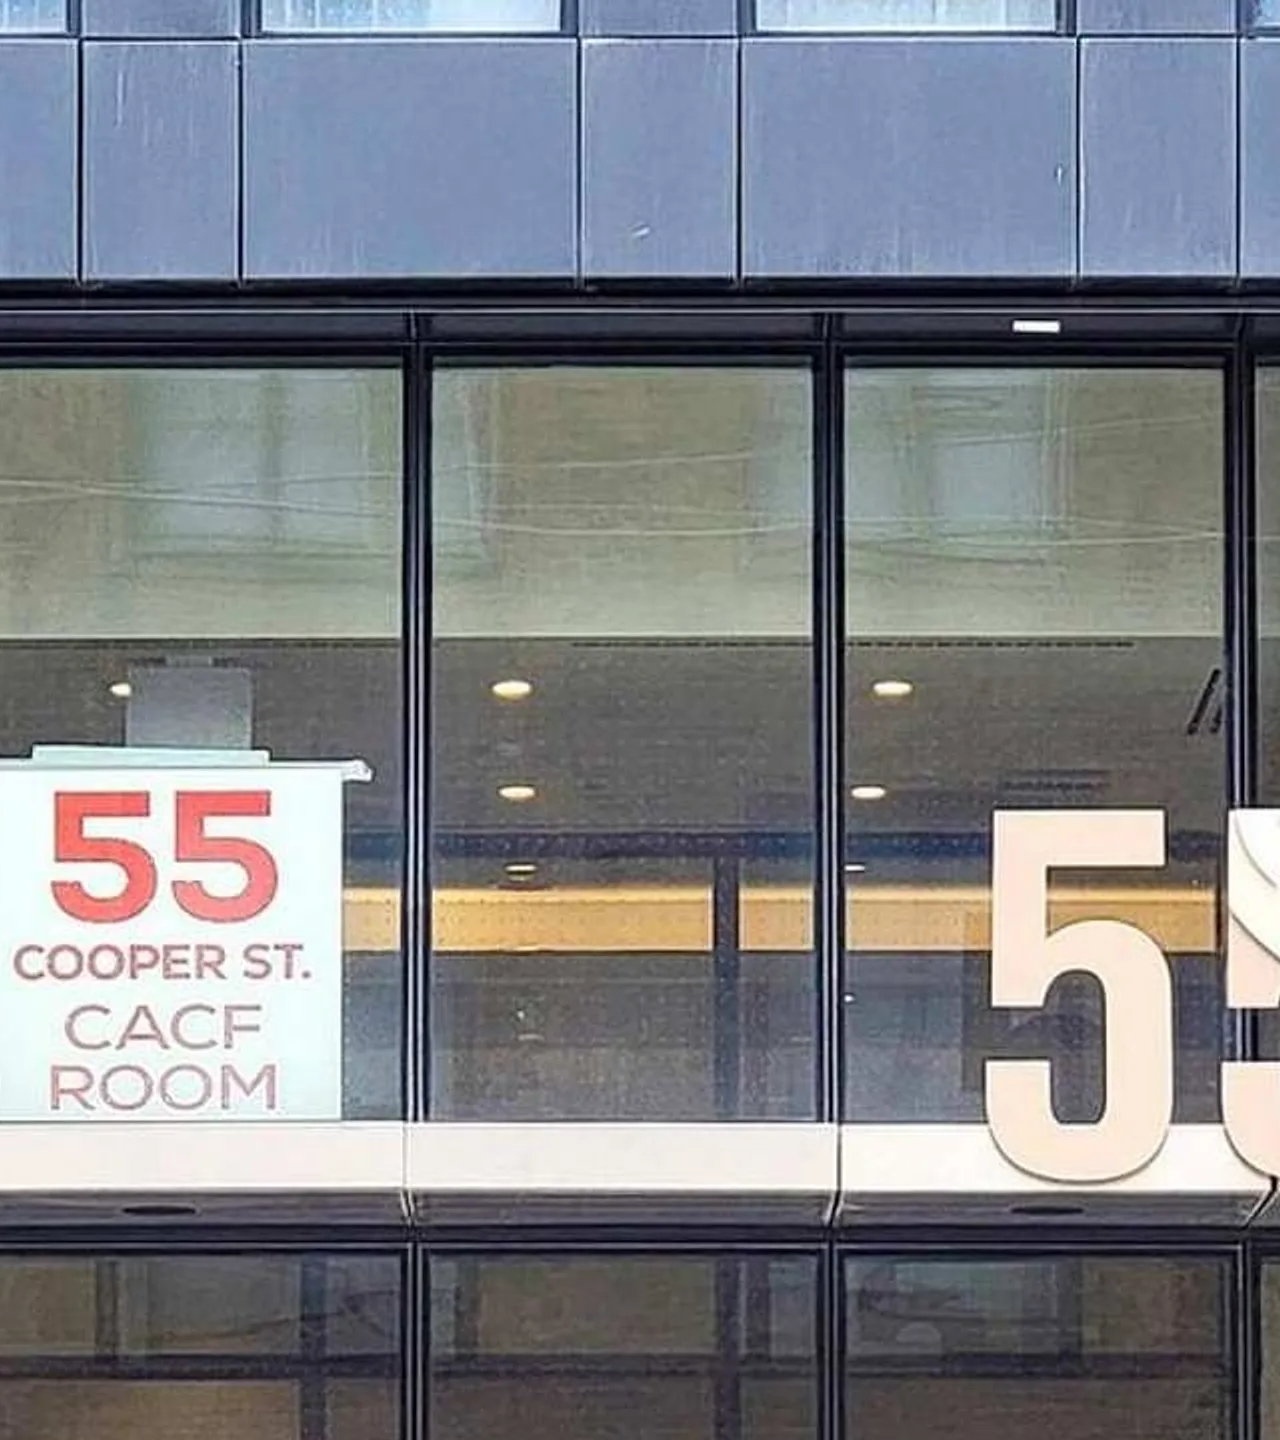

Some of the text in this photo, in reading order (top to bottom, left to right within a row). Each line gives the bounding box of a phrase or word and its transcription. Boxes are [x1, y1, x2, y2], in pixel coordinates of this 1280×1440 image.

[51, 790, 279, 924] 55
[13, 943, 312, 981] COOPER ST.
[64, 1003, 263, 1051] CACF
[49, 1064, 277, 1111] ROOM
